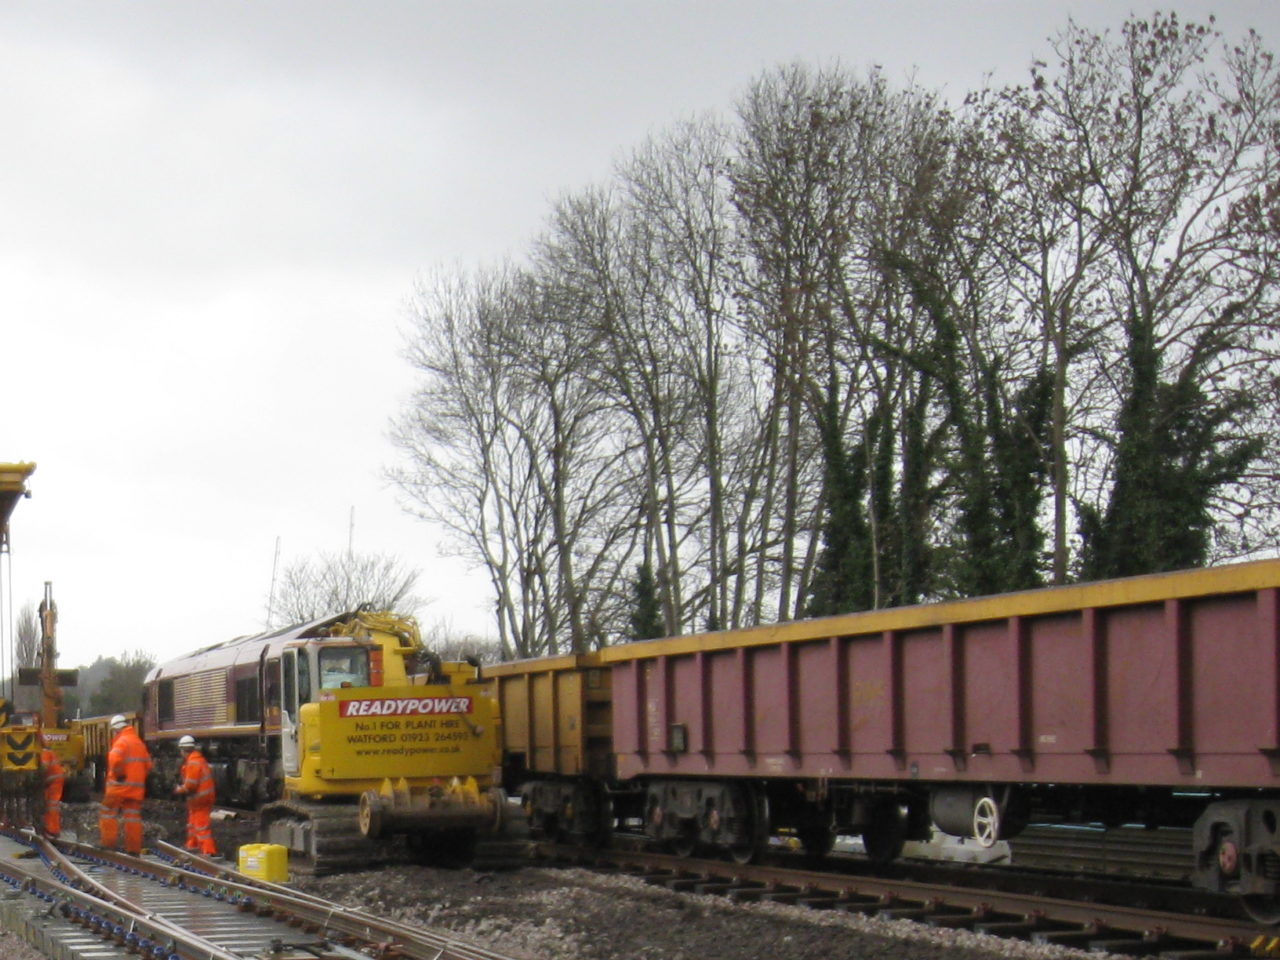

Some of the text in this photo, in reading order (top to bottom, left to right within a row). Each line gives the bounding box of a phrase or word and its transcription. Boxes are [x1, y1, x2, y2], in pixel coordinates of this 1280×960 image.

[346, 697, 470, 716] READYPOWER
[380, 720, 400, 730] FOR
[405, 719, 437, 729] PLANT
[440, 719, 459, 729] HIRE
[346, 733, 396, 744] WATFORD
[355, 744, 462, 756] www.readypower.co.uk
